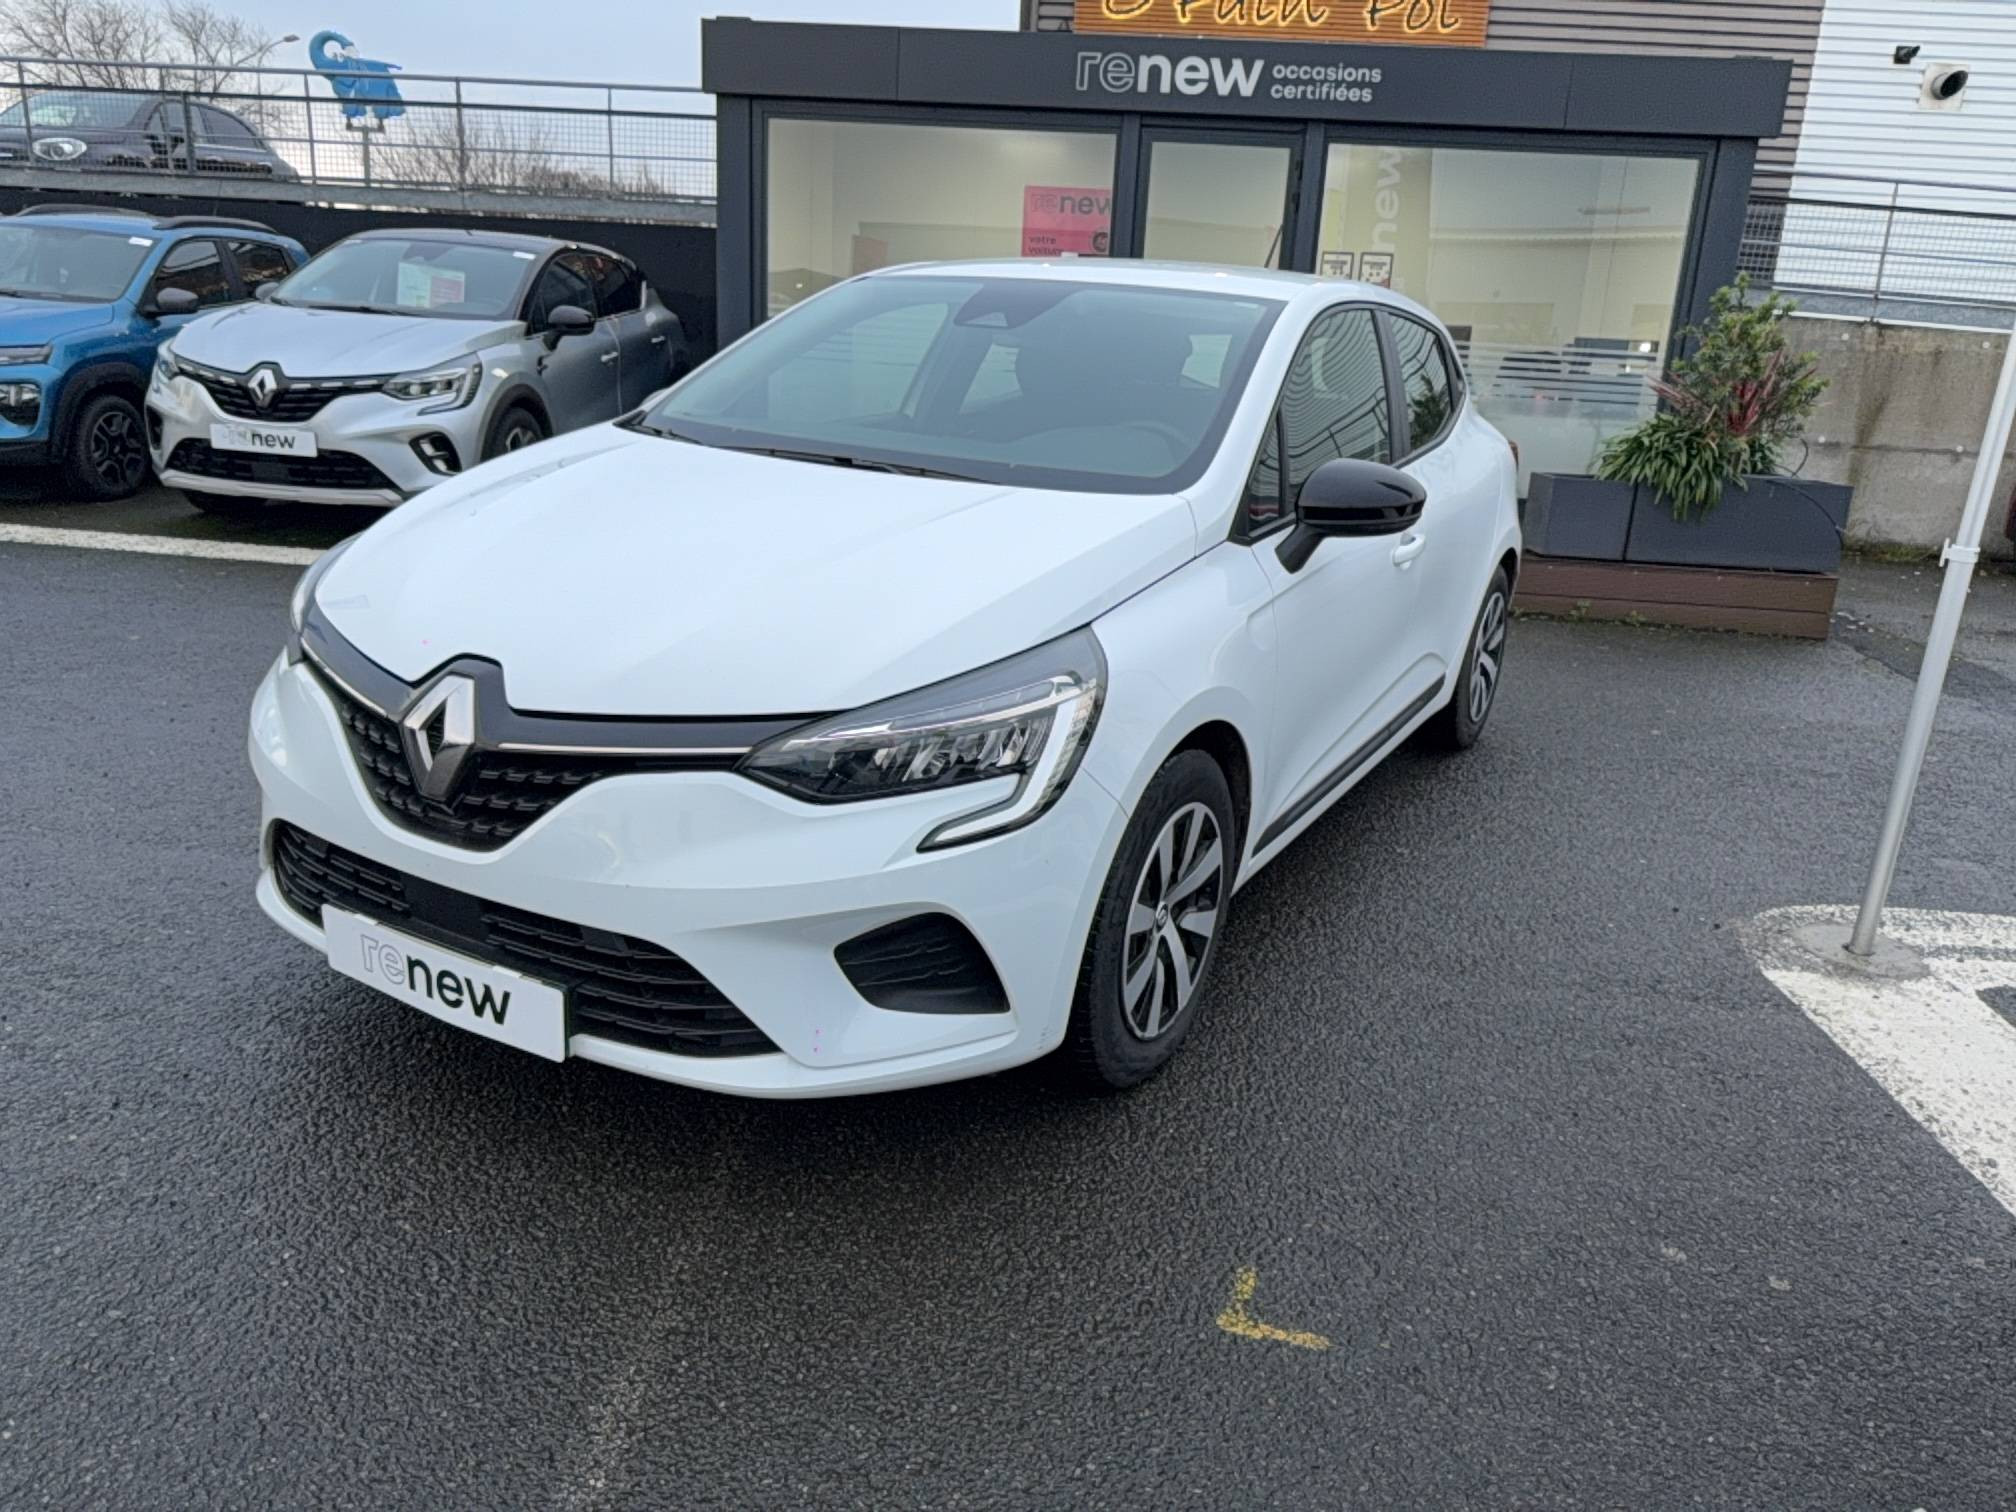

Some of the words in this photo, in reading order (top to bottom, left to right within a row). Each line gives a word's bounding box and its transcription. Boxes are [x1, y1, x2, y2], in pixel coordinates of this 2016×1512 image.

[1075, 52, 1265, 97] renew
[1272, 62, 1382, 83] occasions
[1270, 82, 1373, 103] certifiées
[360, 934, 511, 1026] renew
